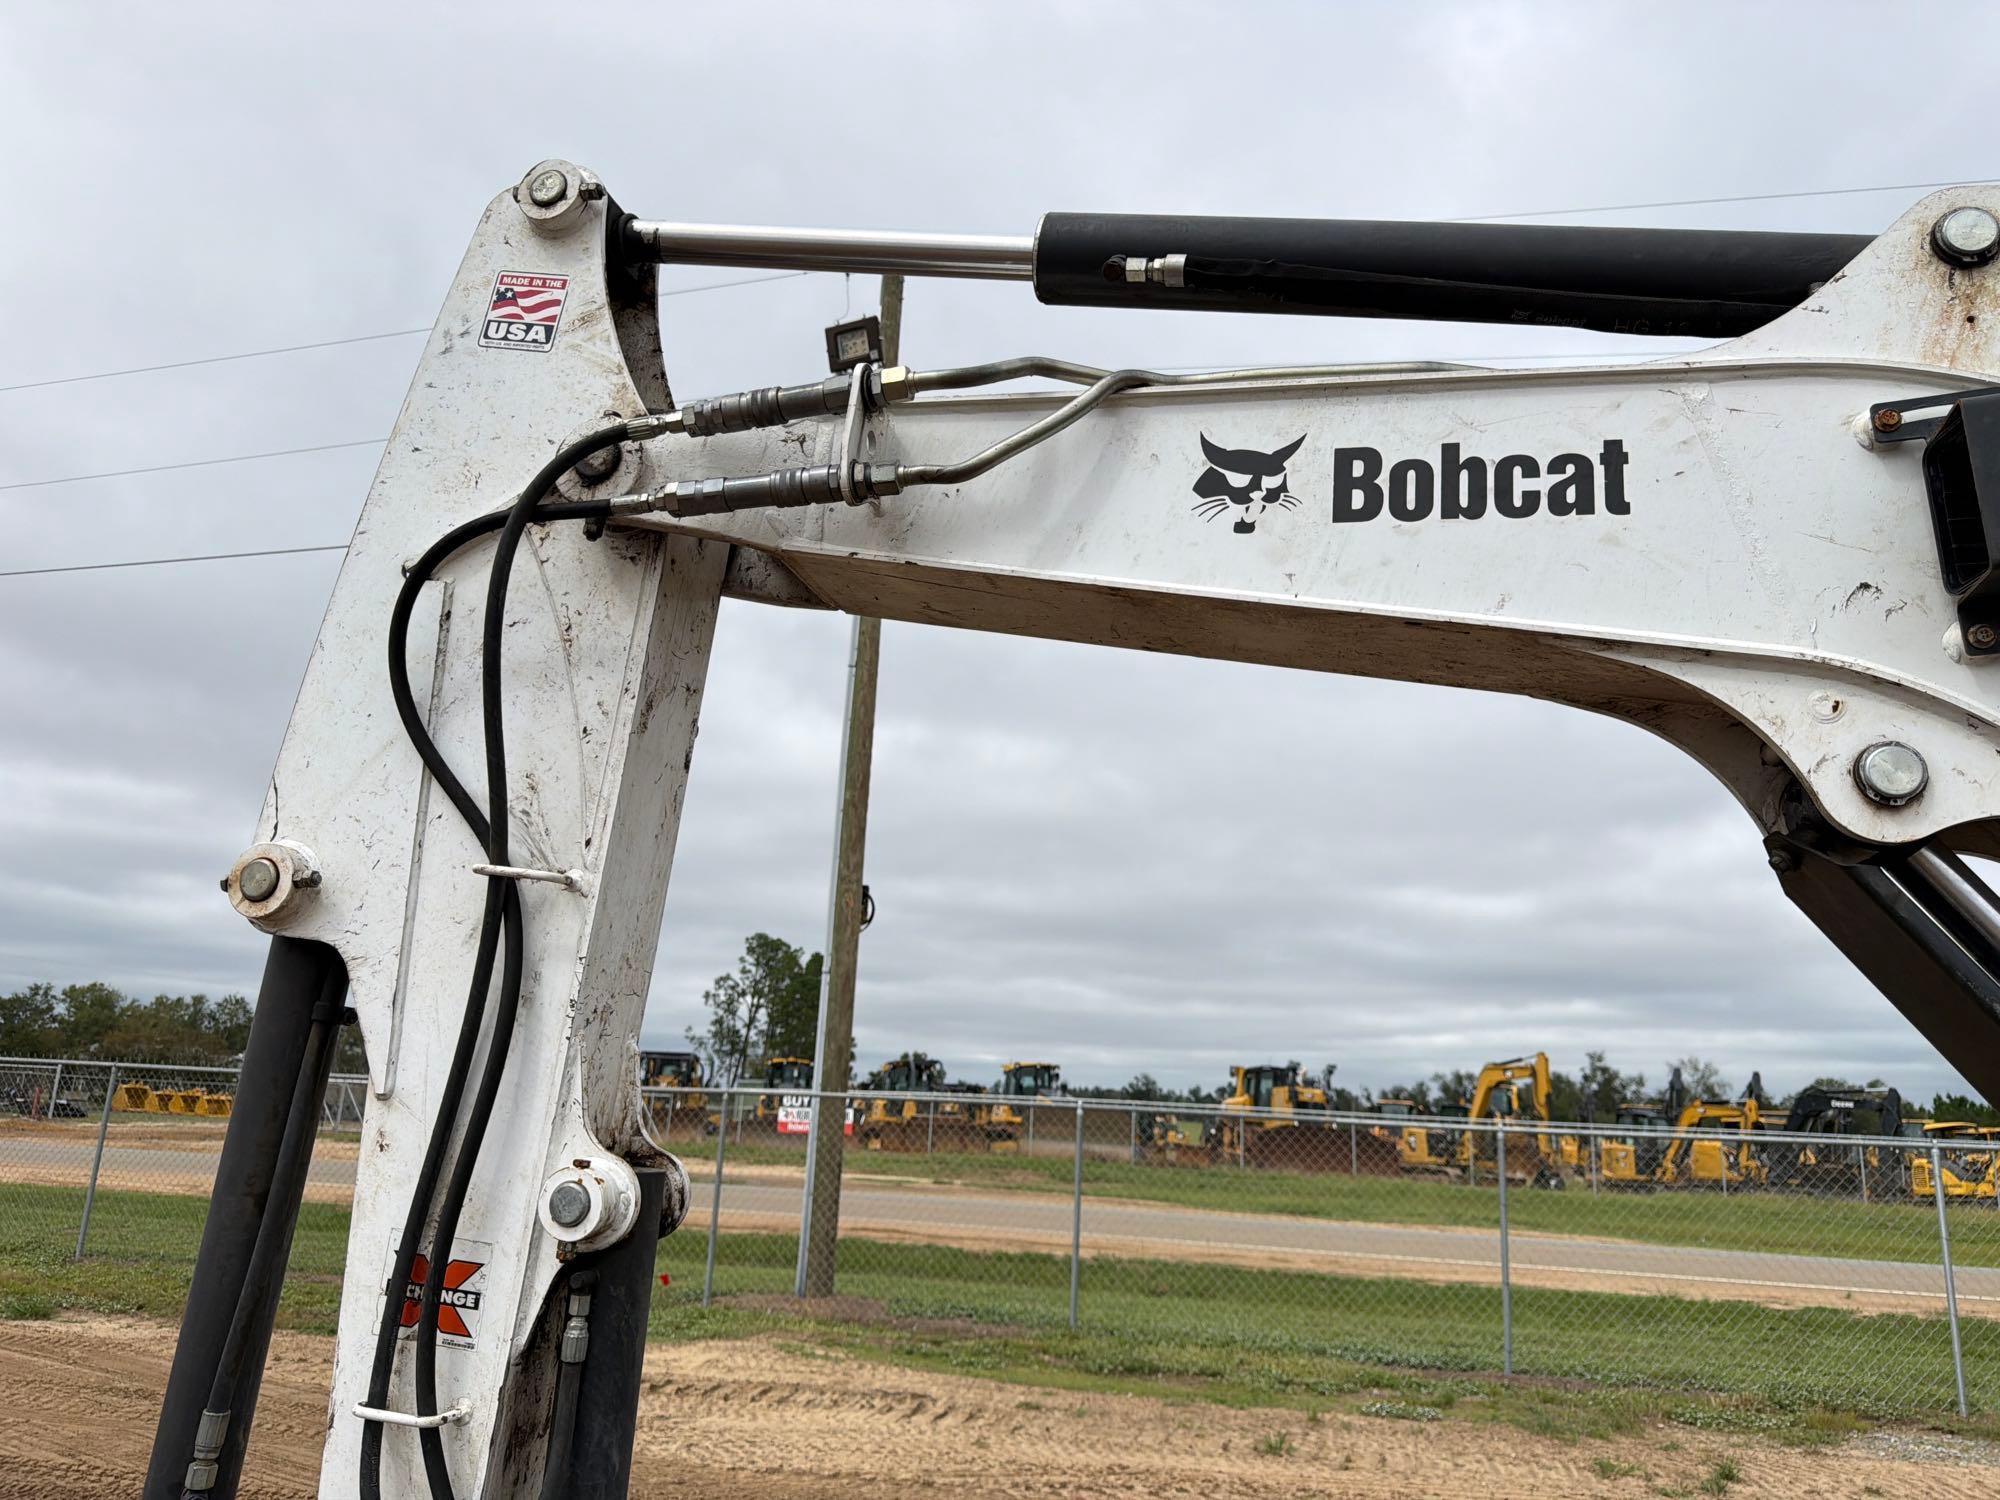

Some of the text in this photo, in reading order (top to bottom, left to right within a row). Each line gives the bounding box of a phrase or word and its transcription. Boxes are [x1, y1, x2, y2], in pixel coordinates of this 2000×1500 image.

[502, 276, 563, 288] MADE IN THE
[487, 321, 547, 343] USA
[1332, 439, 1631, 523] Bobcat
[405, 1284, 476, 1308] CHNGE
